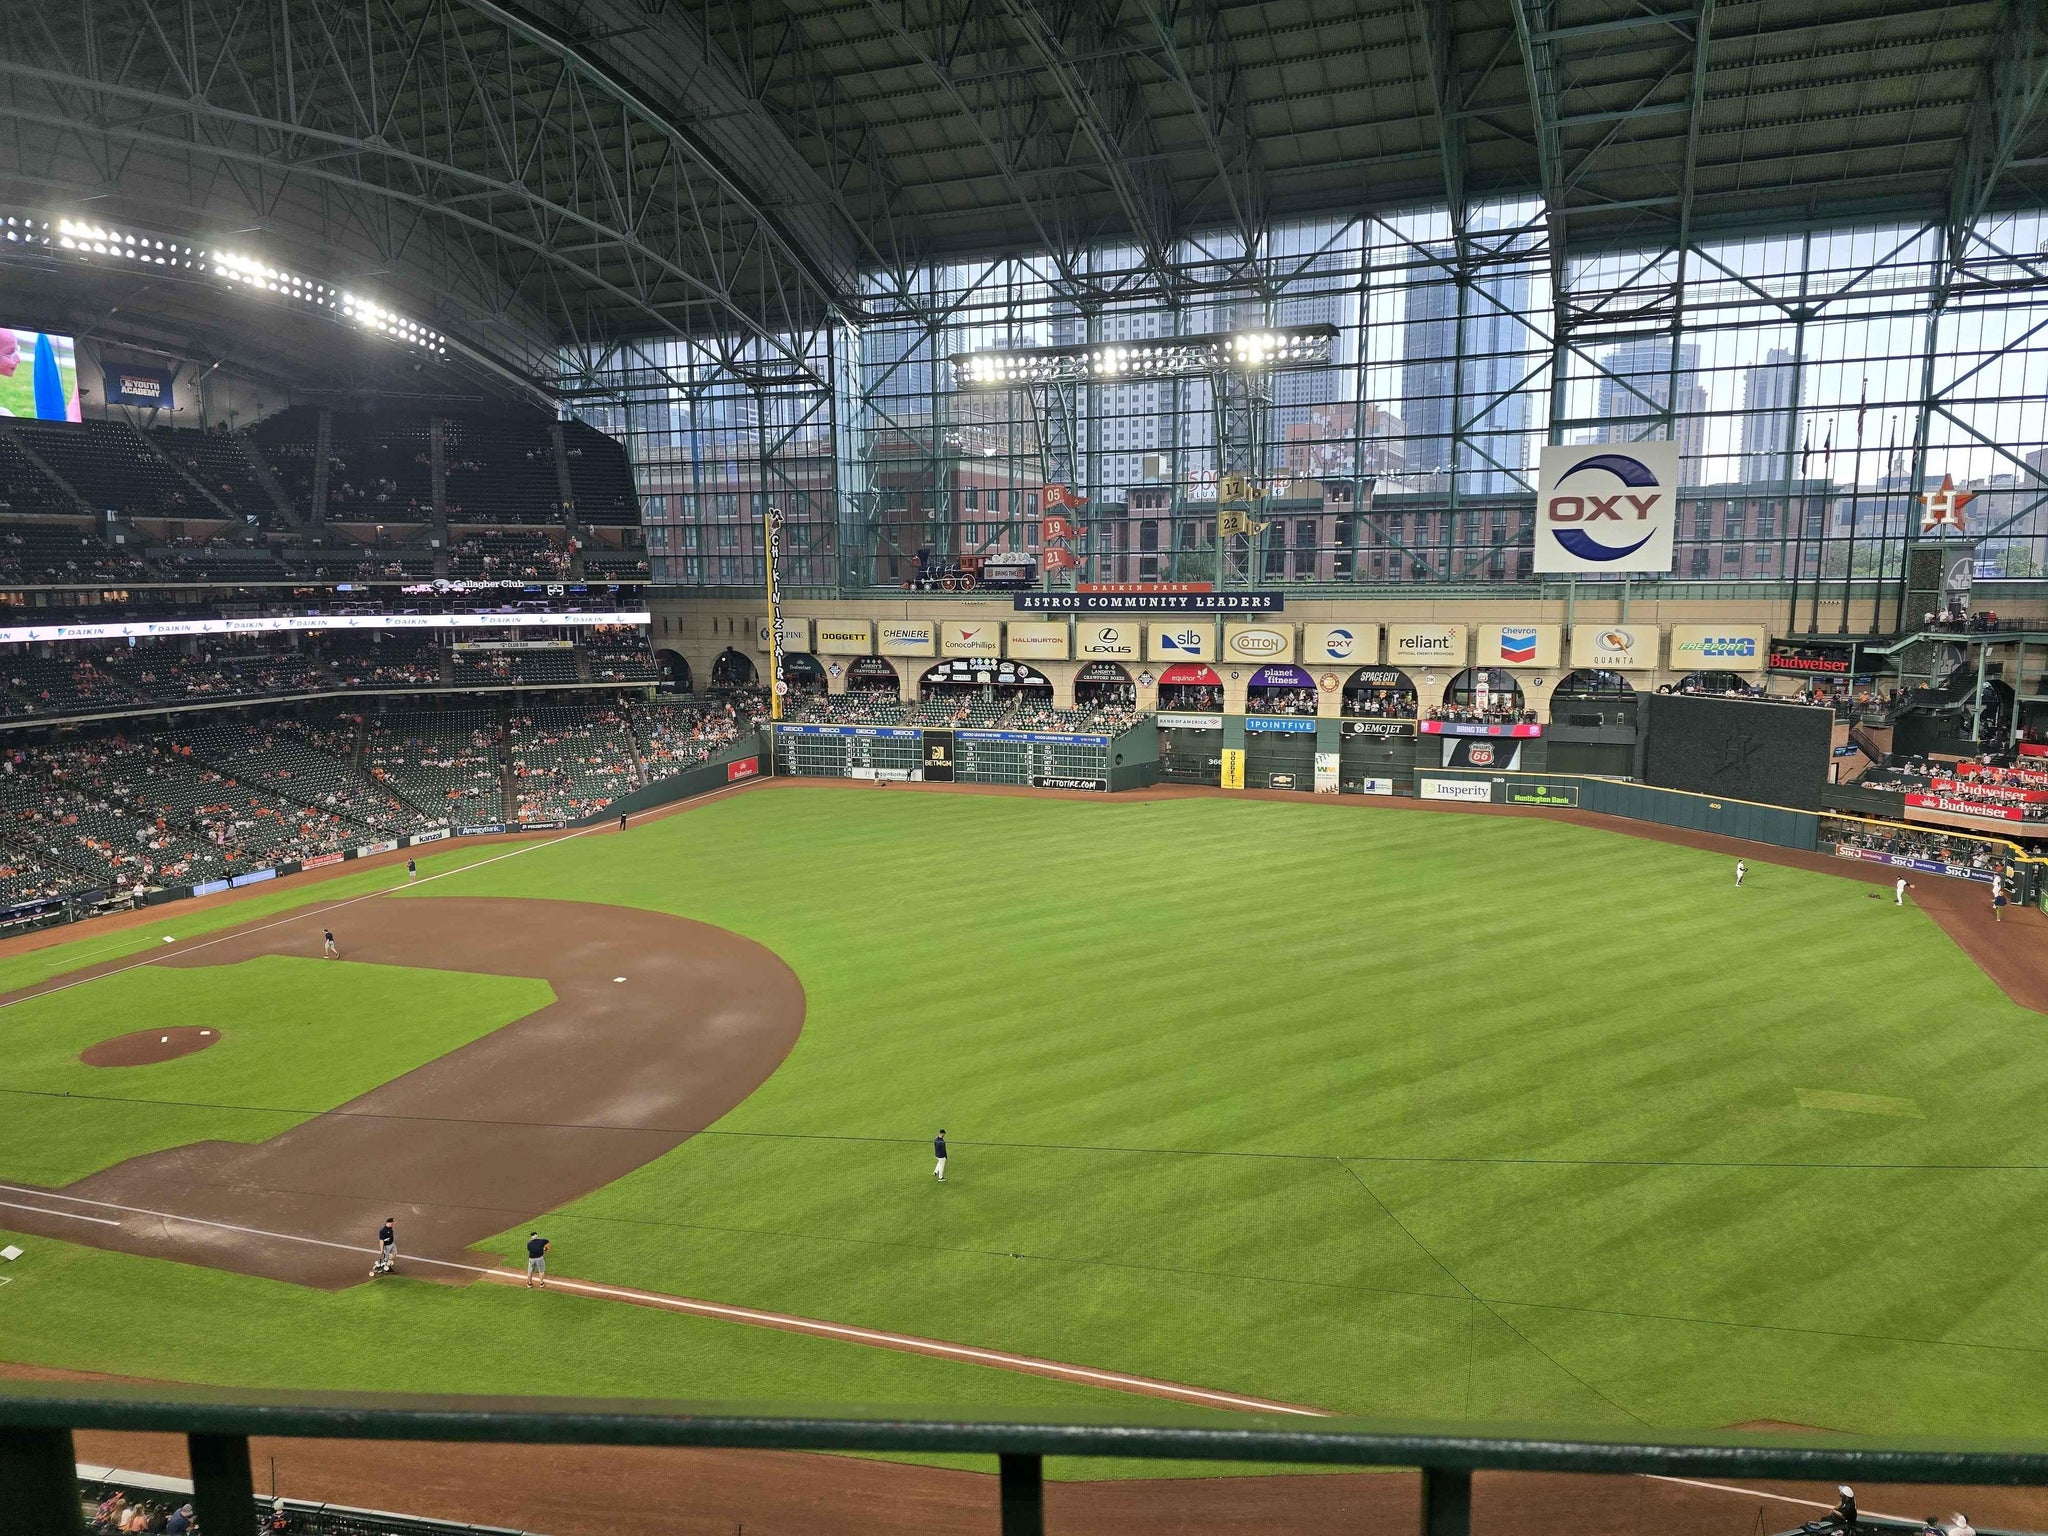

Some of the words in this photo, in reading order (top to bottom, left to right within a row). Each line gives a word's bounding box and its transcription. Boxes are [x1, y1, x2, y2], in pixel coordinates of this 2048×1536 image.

[133, 380, 160, 390] YOUTH
[121, 386, 160, 397] ACADEMY
[1226, 482, 1239, 495] 17
[1047, 489, 1060, 502] 05
[1549, 494, 1662, 521] OXY
[1048, 521, 1061, 533] 19
[1224, 518, 1238, 529] 22
[1047, 552, 1059, 564] 21
[453, 580, 501, 589] Gallagher
[501, 580, 524, 588] Club
[1023, 597, 1081, 607] ASTROS
[1088, 597, 1187, 607] COMMUNITY
[1196, 596, 1272, 607] LEADERS
[883, 629, 930, 638] CHENIERE
[1502, 627, 1537, 635] Chevron
[822, 633, 866, 641] DOGGETT
[1177, 630, 1201, 645] slb
[1399, 635, 1449, 649] reliant
[945, 640, 996, 650] ConocoPhillips
[1085, 645, 1132, 654] LEXUS
[1594, 656, 1634, 665] QUANTA
[1769, 653, 1849, 672] Budweiser
[1264, 668, 1293, 679] planet
[1360, 671, 1383, 682] SPACE
[1383, 672, 1400, 681] CITY
[1171, 675, 1196, 683] equinor
[1268, 675, 1299, 684] fitness
[1250, 721, 1312, 730] 1POINTFIVE
[1364, 724, 1403, 734] EMCJET
[1475, 726, 1488, 734] THE
[1473, 751, 1489, 761] 66
[925, 759, 952, 767] BETMGM
[1043, 779, 1096, 789] NITTOTIRE.COM
[1437, 784, 1489, 797] Insperity
[1956, 781, 2027, 801] Budweiser
[1514, 794, 1551, 804] Huntington
[1551, 796, 1569, 804] Bank
[1939, 798, 2008, 818] Budweiser
[273, 1520, 287, 1529] 27
